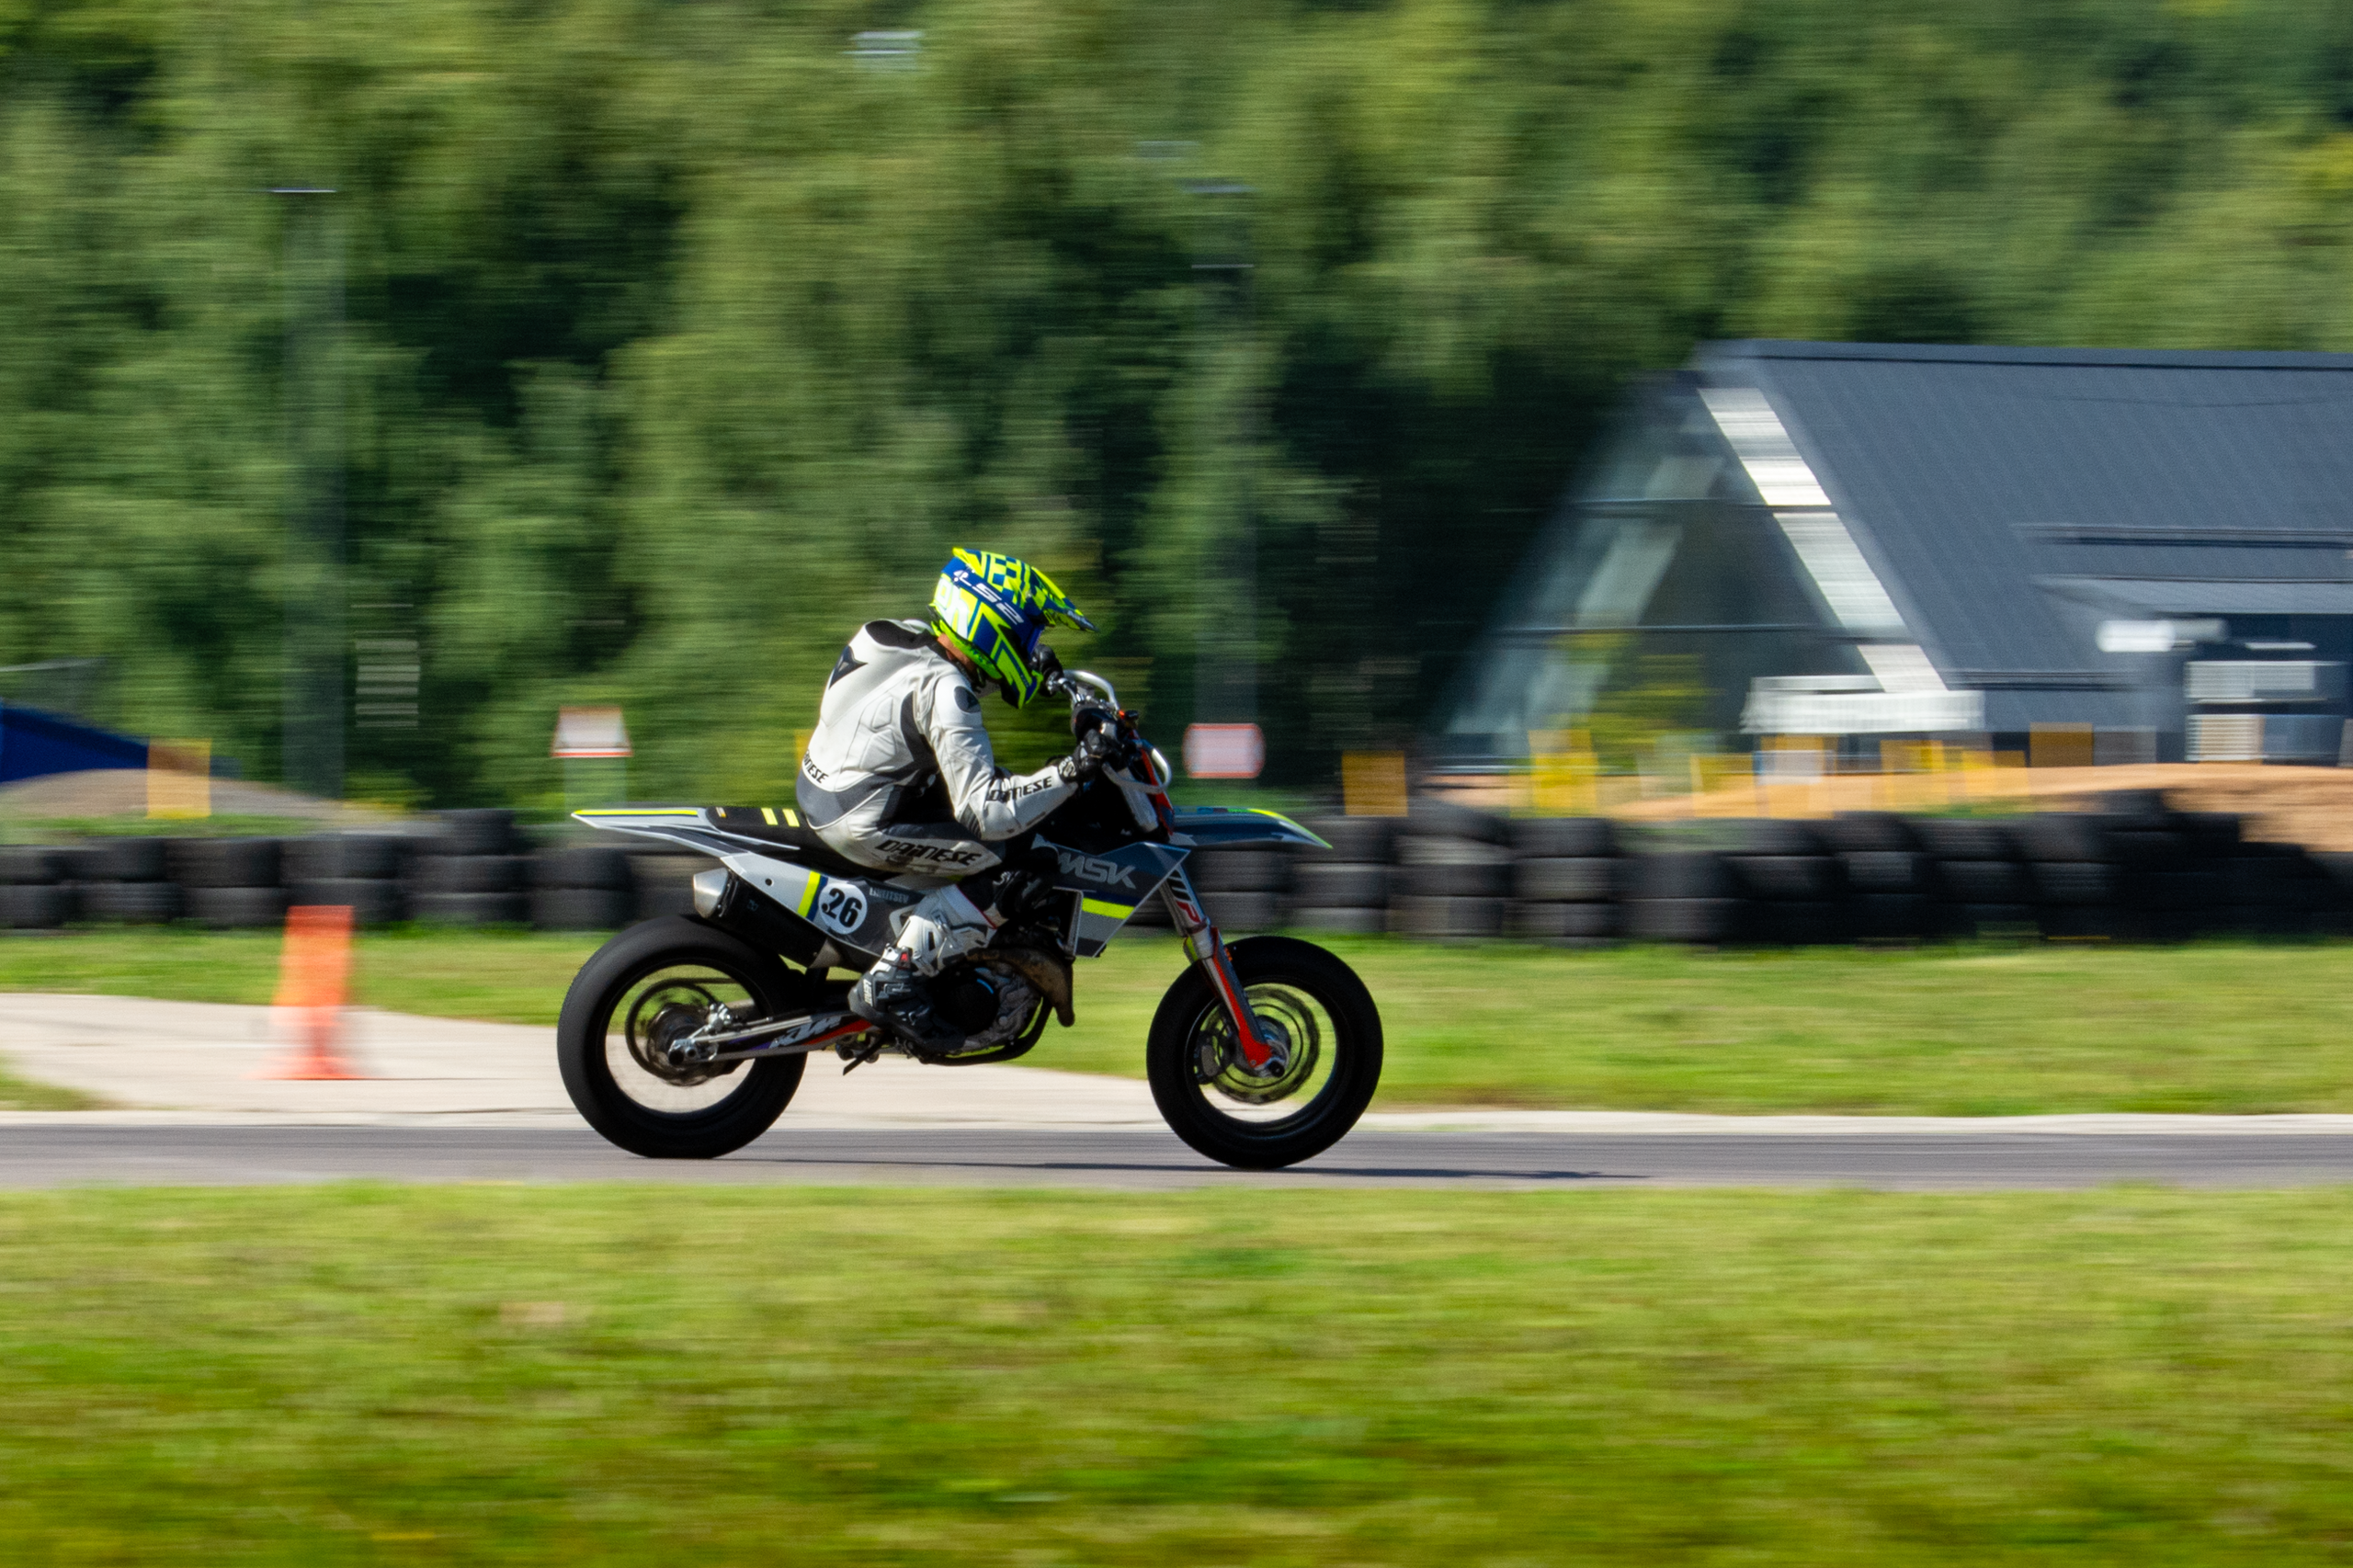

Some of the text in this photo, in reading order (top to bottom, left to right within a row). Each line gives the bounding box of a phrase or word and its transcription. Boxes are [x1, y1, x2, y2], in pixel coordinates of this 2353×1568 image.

[953, 569, 1025, 626] LS2
[875, 839, 982, 866] DAINESE
[821, 888, 863, 928] 26
